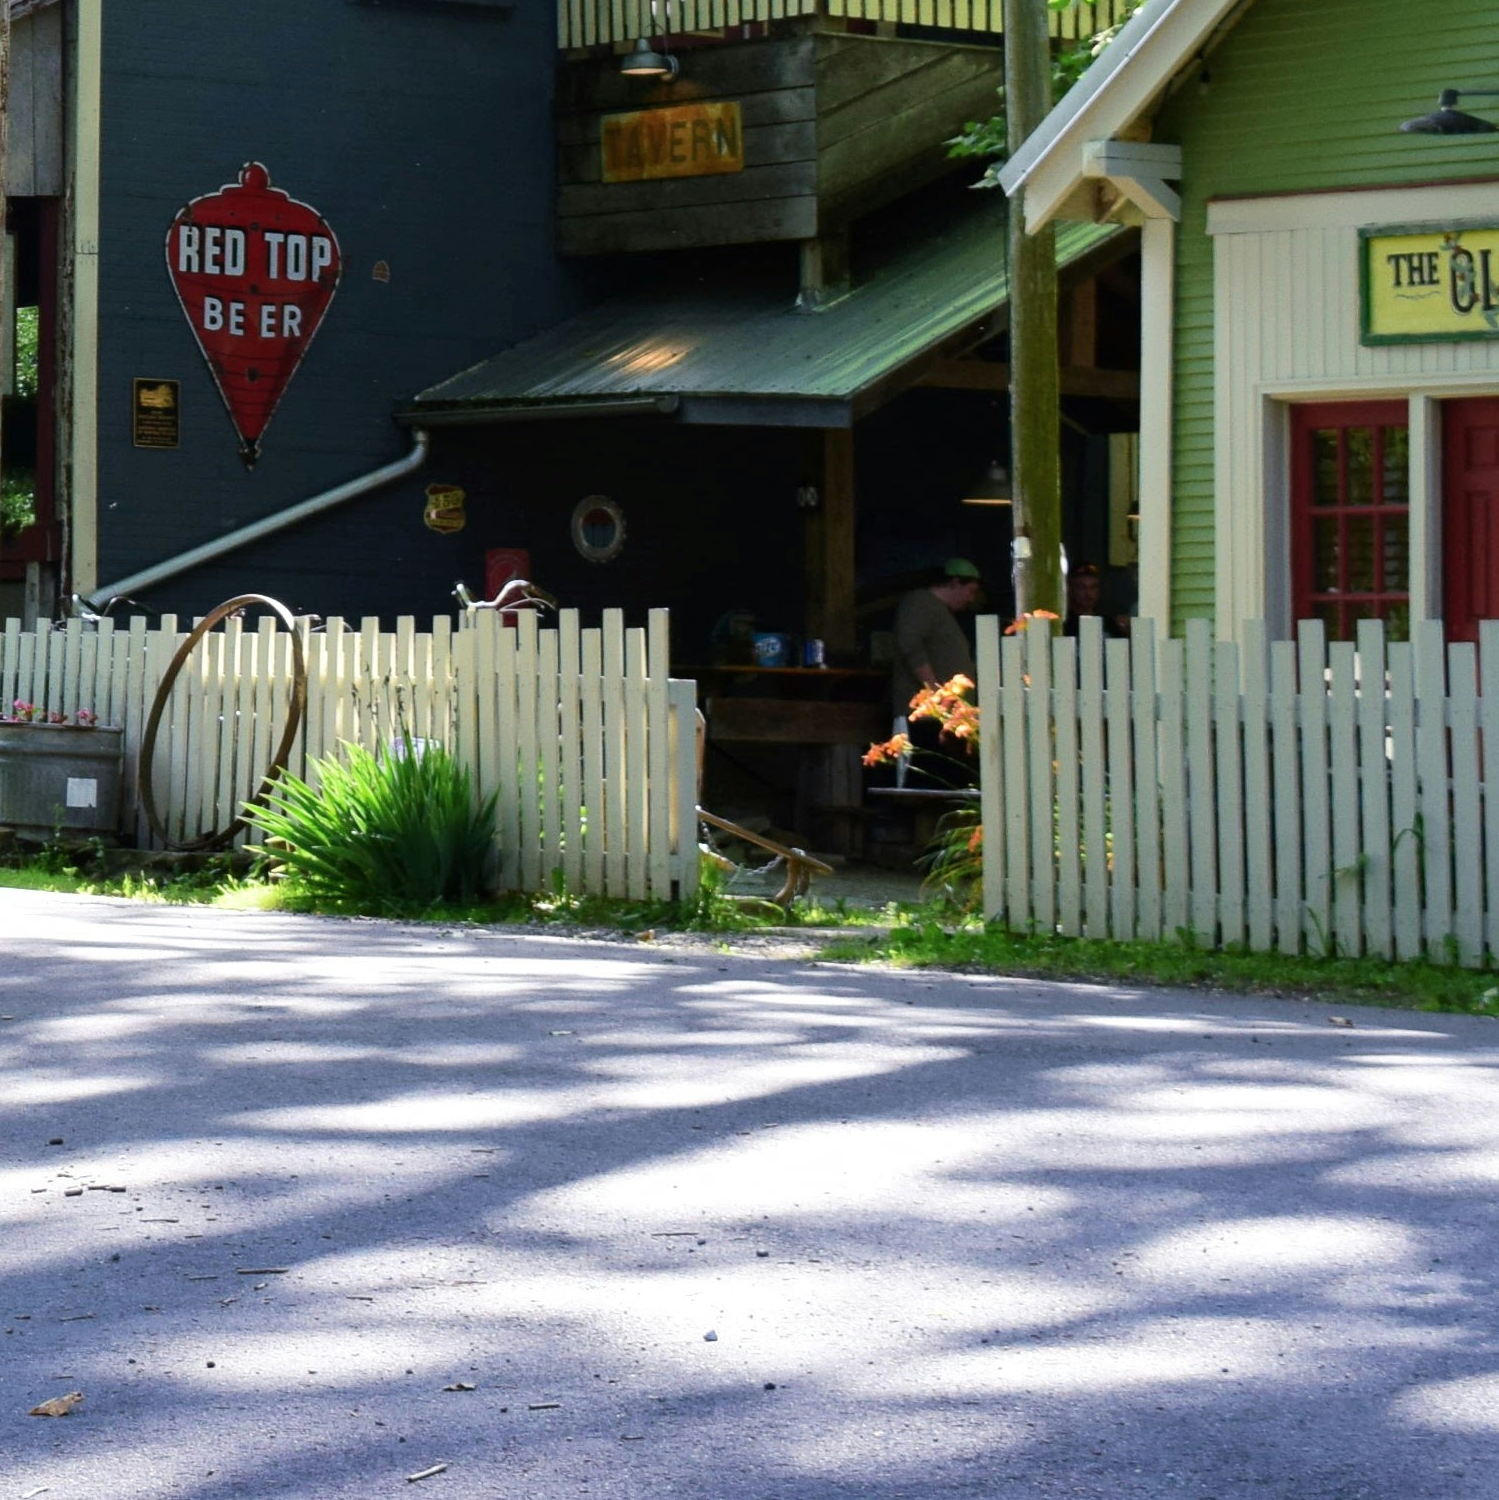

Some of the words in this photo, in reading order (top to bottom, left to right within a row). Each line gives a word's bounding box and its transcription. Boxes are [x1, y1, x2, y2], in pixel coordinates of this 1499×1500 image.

[605, 116, 739, 169] TAVERN
[178, 225, 245, 276] RED
[264, 231, 332, 282] TOP
[1387, 252, 1440, 287] THE
